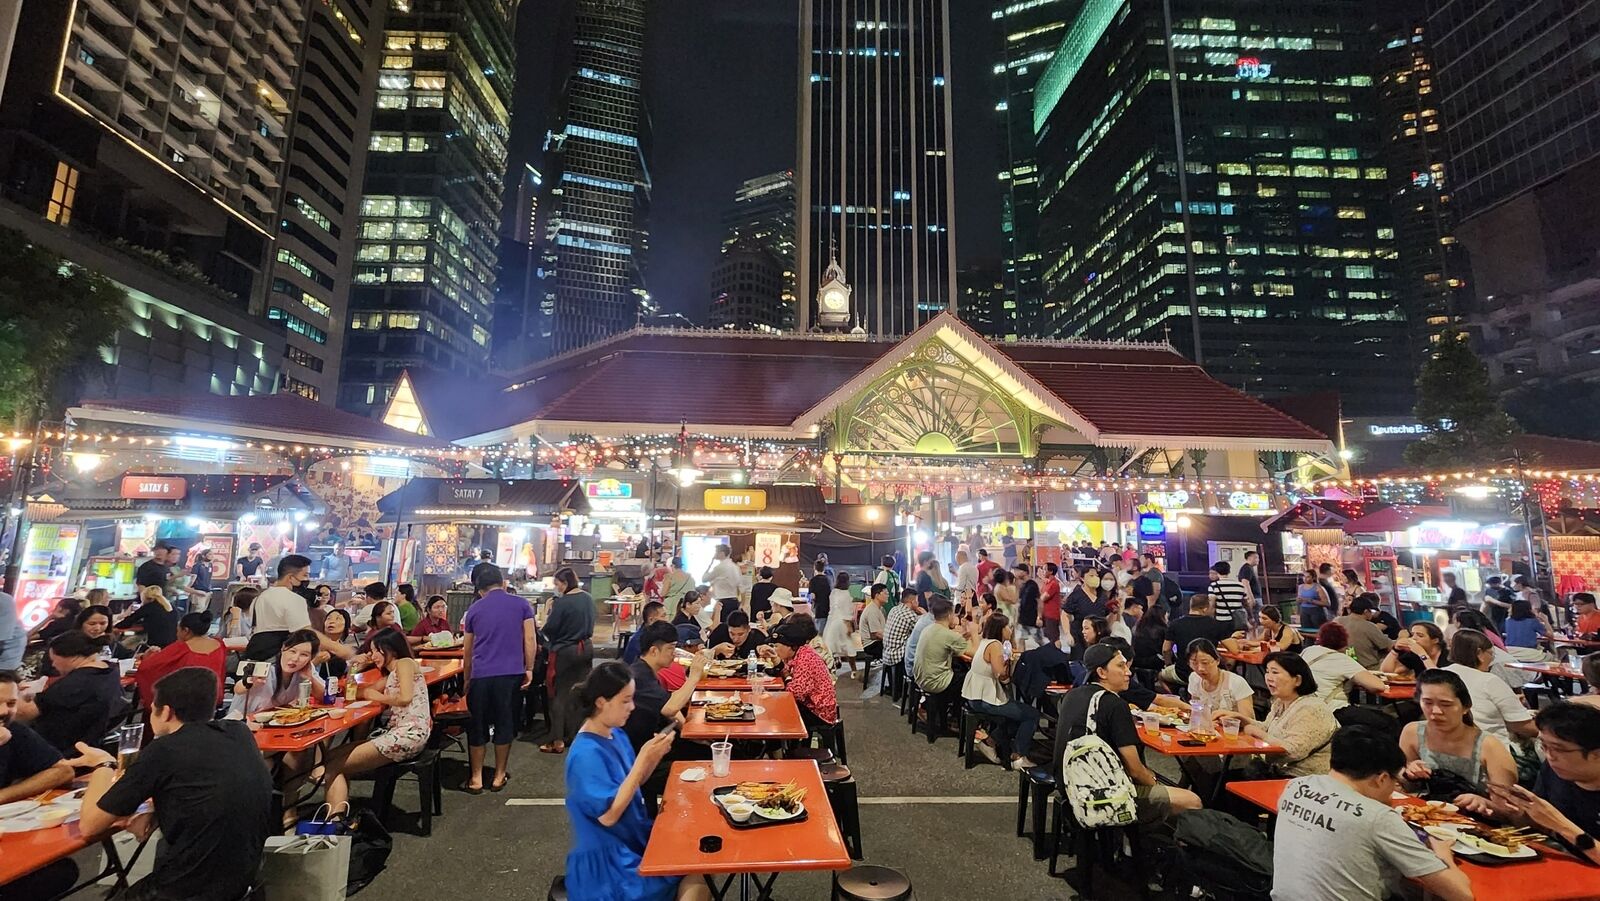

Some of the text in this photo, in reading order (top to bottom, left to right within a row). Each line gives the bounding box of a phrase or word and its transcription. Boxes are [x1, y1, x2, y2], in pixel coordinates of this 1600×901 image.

[1370, 424, 1414, 434] Deutsche
[139, 482, 169, 493] SATAY 6
[454, 489, 483, 499] SATAY 7
[721, 495, 750, 505] SATAY 8
[762, 548, 773, 564] 8
[22, 599, 50, 629] 6
[1336, 799, 1365, 818] IT'S
[1281, 799, 1337, 833] OFFICIAL
